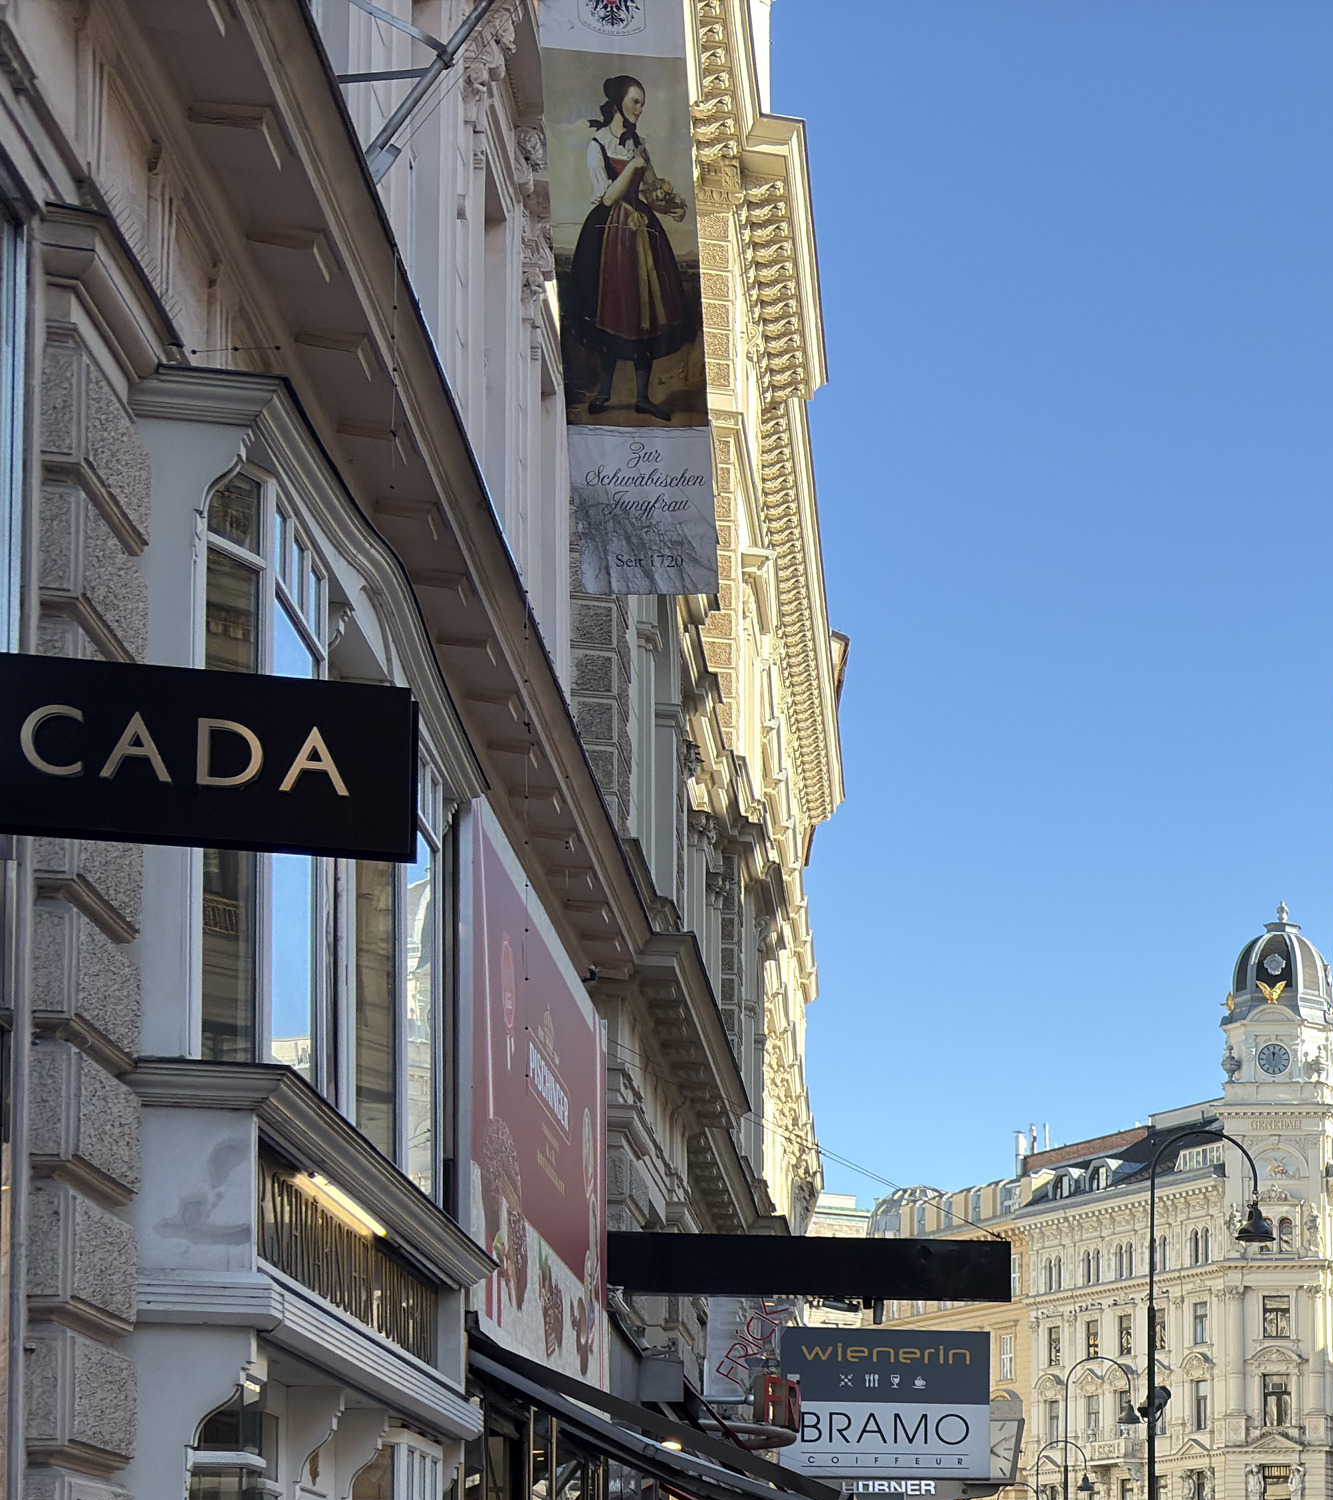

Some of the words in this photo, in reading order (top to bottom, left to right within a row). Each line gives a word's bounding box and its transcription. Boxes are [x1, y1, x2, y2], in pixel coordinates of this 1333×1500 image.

[627, 441, 663, 469] Zur
[585, 464, 706, 488] Schwäbischen
[602, 490, 691, 521] Jungfrau
[616, 554, 645, 568] Seit
[651, 554, 684, 568] 1720
[20, 704, 350, 797] CADA
[801, 1342, 971, 1365] wienerin
[801, 1411, 970, 1446] BRAMO
[808, 1455, 964, 1466] COIFFEUR
